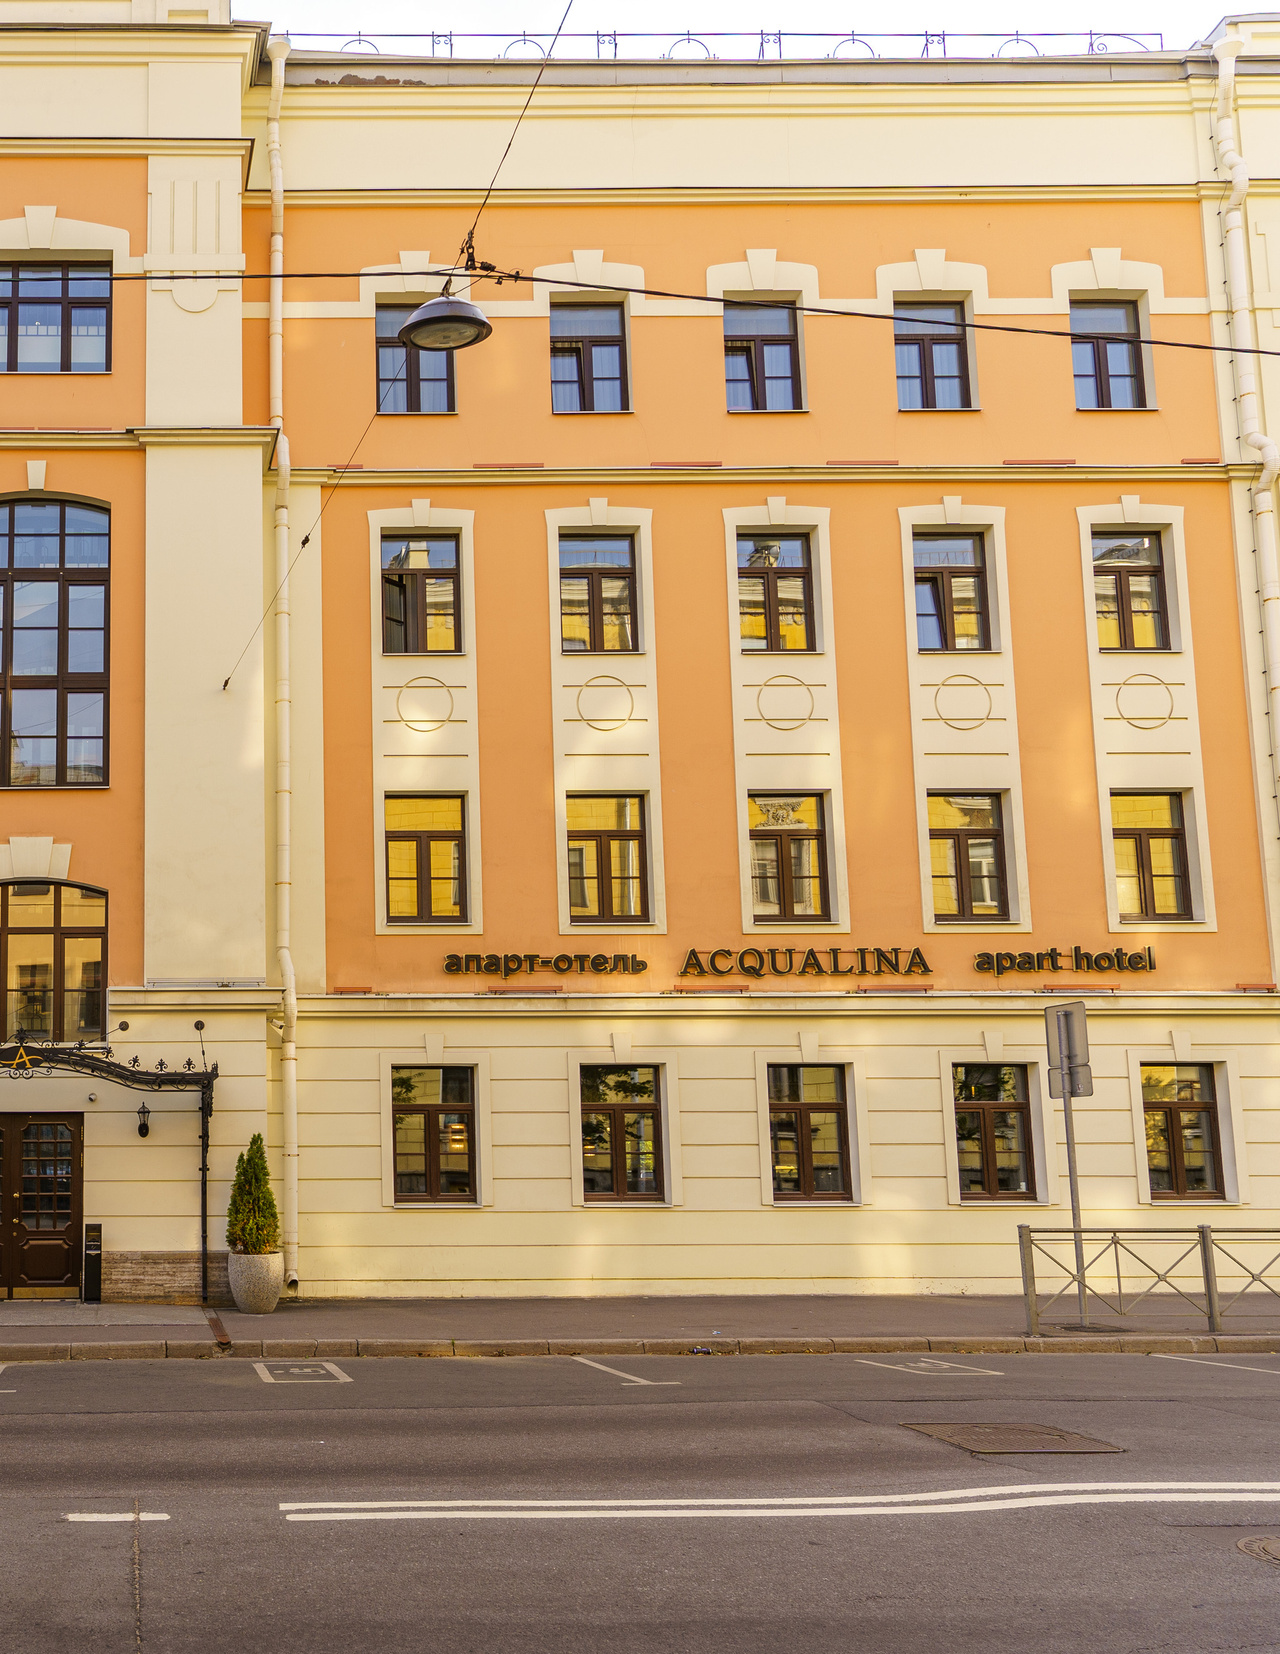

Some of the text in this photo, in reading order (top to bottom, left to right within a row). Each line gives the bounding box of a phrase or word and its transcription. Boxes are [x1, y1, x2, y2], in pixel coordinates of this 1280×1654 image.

[443, 953, 648, 979] апарт-отель
[678, 947, 933, 979] ACQUALINA
[974, 945, 1156, 977] apart hotel
